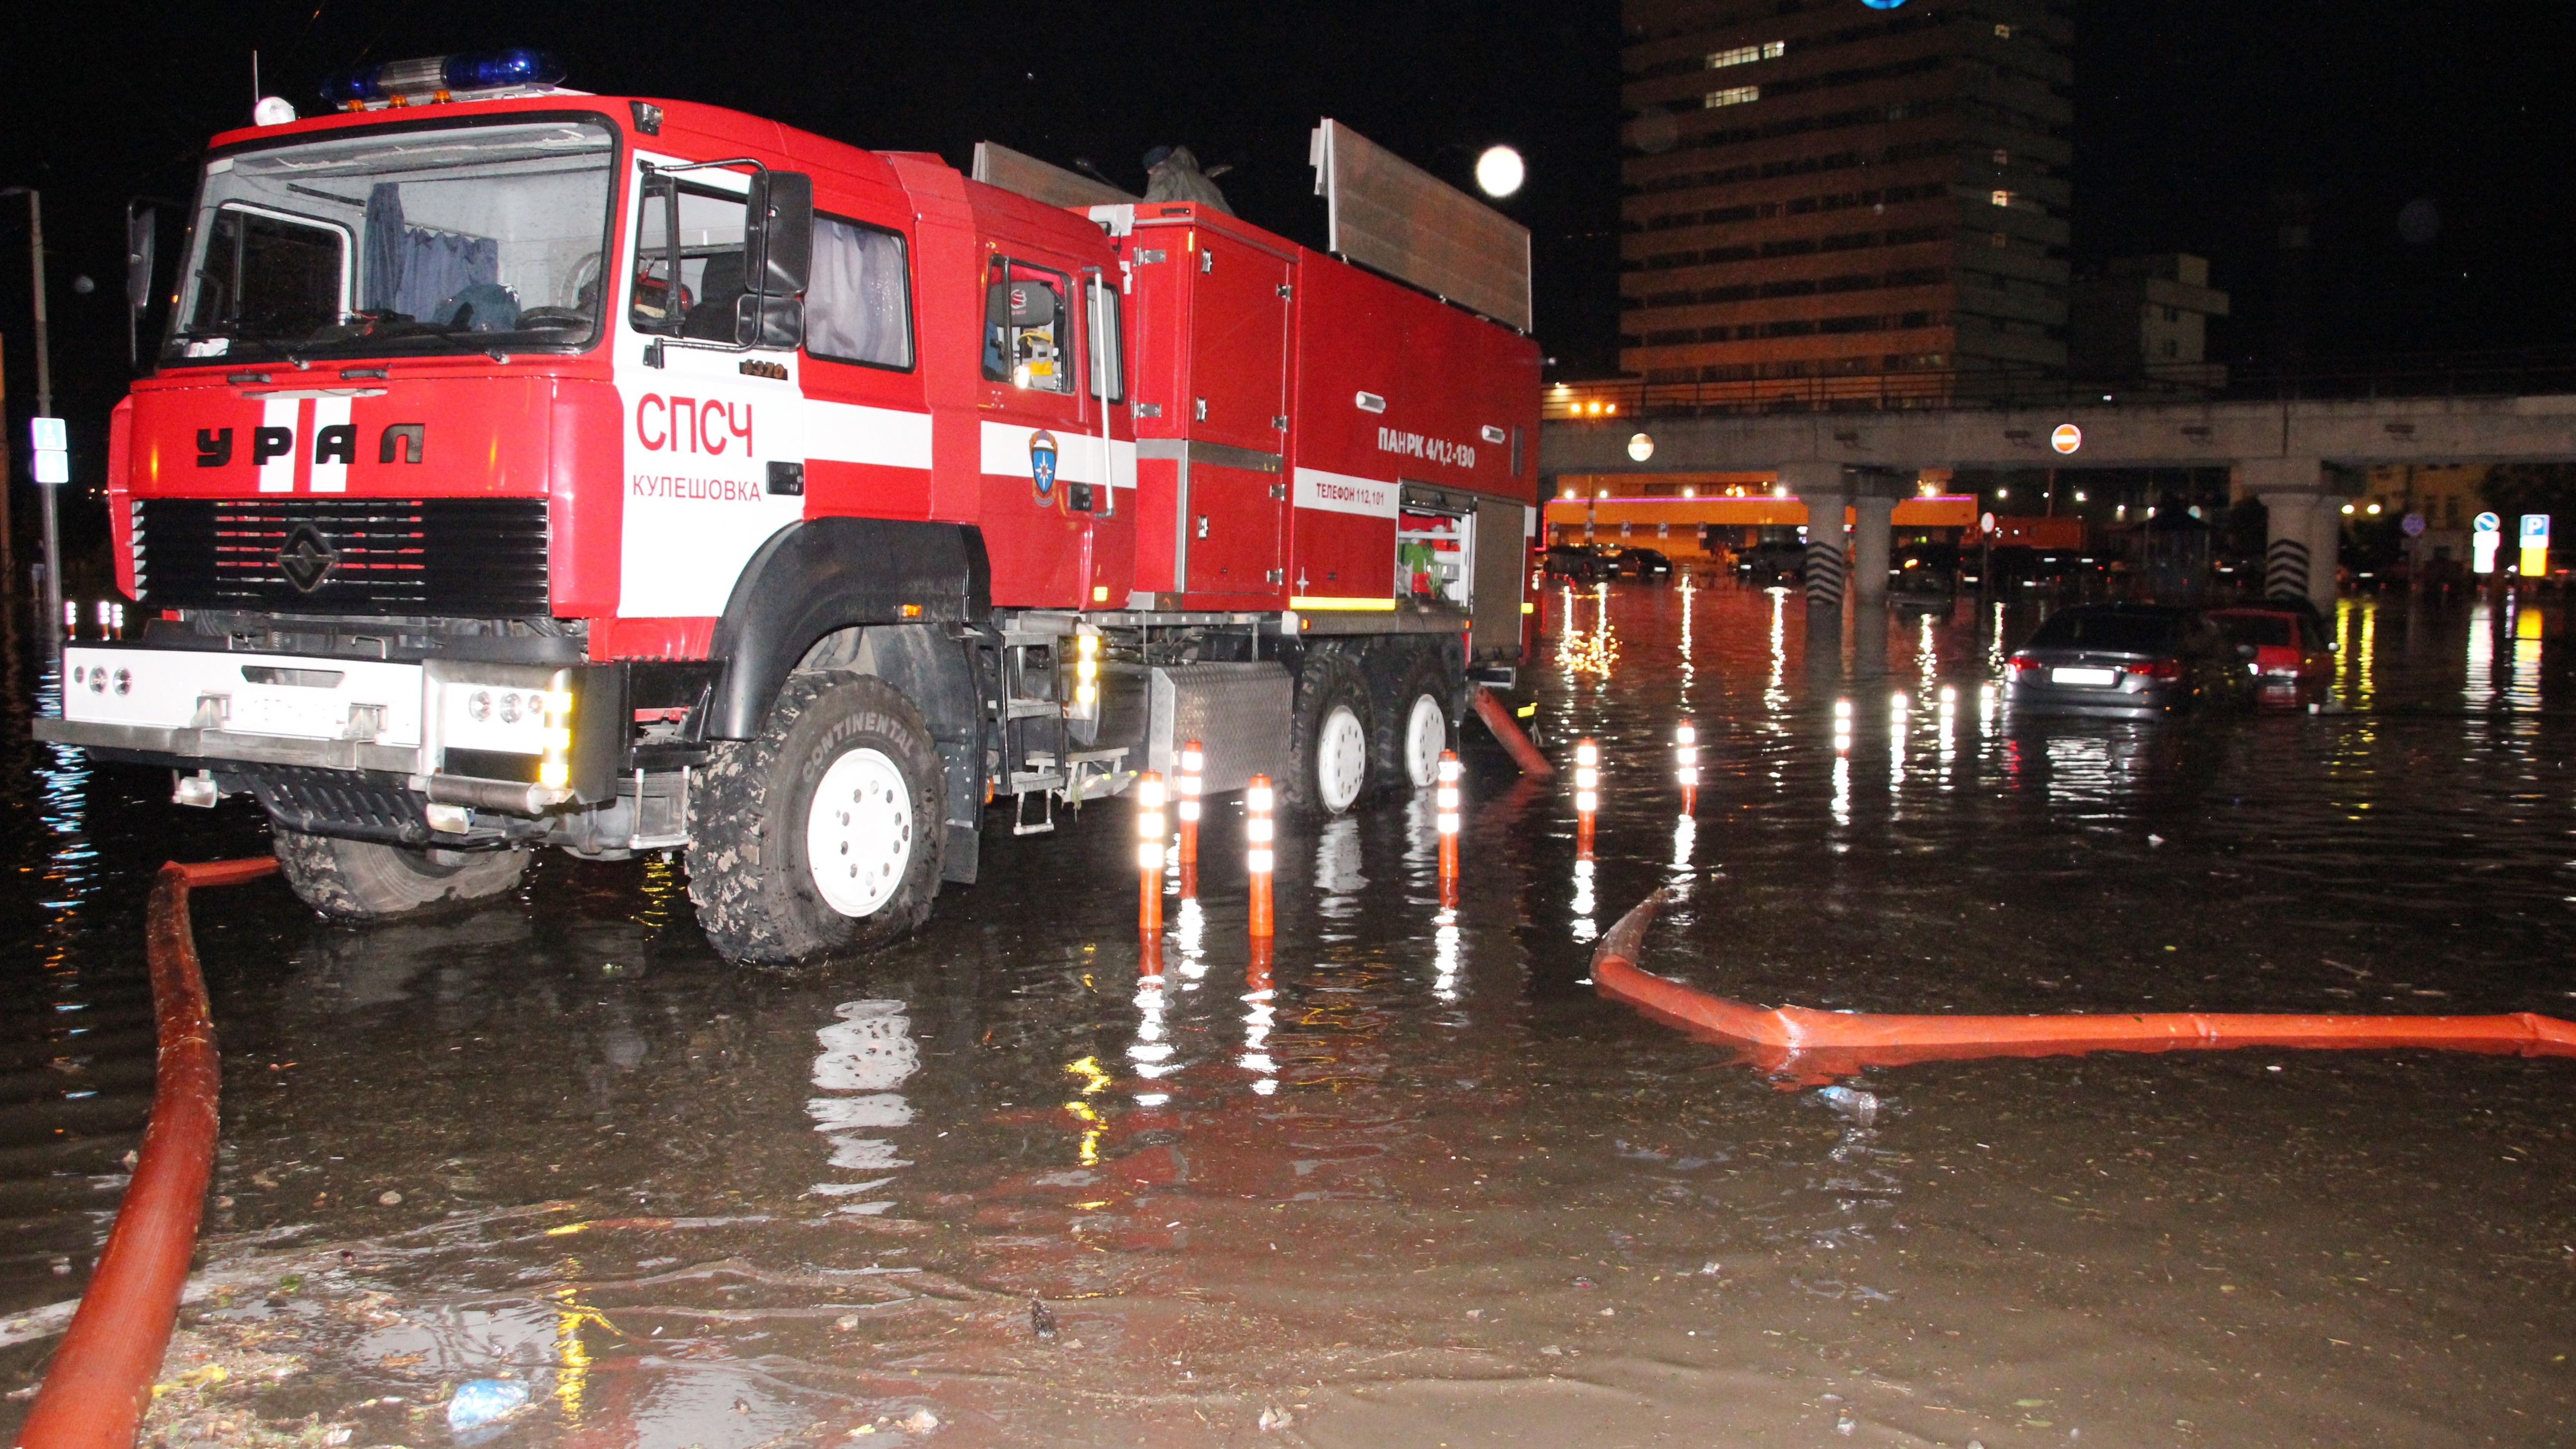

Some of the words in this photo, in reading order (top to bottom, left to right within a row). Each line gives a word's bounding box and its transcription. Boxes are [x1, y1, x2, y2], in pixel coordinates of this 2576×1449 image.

[197, 423, 425, 467] УРАЛ
[637, 393, 752, 457] СПСЧ
[1378, 426, 1424, 458] ПАНРК
[1426, 438, 1475, 469] 4/1,2-130
[633, 475, 761, 502] КУЛЕШОВКА
[1316, 483, 1355, 501] ТЕЛЕФОН
[2527, 517, 2543, 535] P
[803, 711, 914, 782] CONTINENTAL
